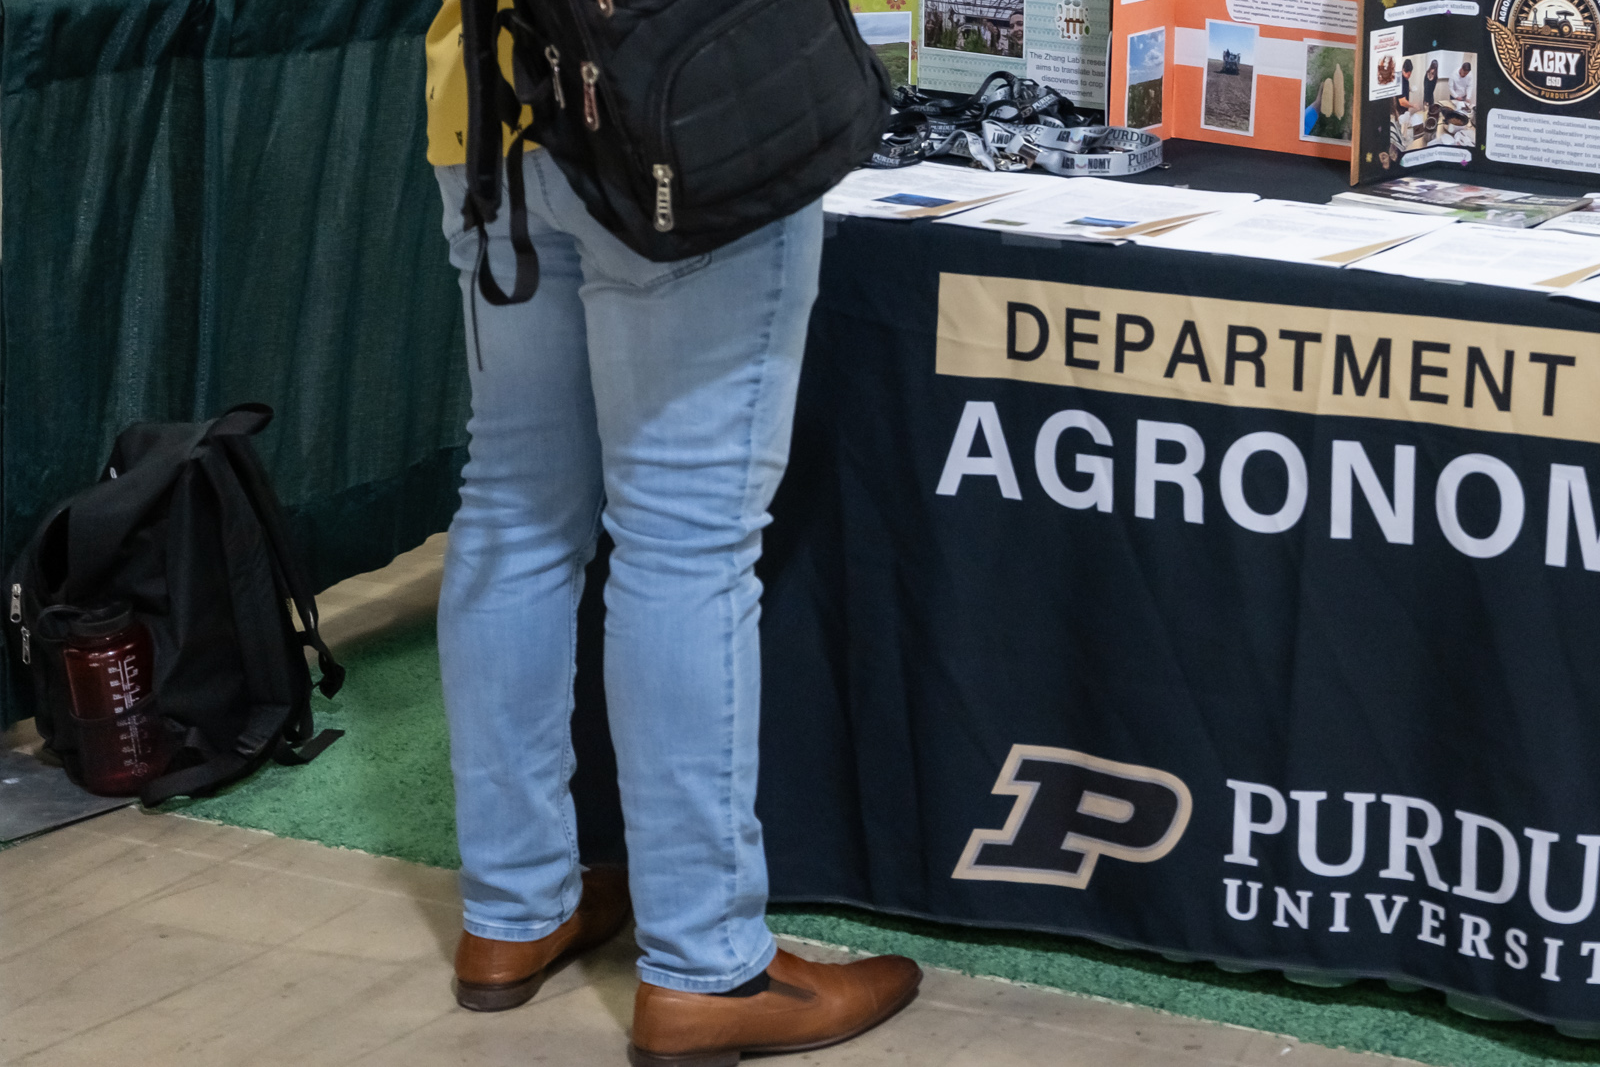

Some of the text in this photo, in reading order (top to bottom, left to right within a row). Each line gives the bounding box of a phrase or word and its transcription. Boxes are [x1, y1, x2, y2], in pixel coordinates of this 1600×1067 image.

[1528, 49, 1581, 76] AGRY
[1540, 89, 1569, 99] PURDUE
[1005, 301, 1577, 417] DEPARTMENT
